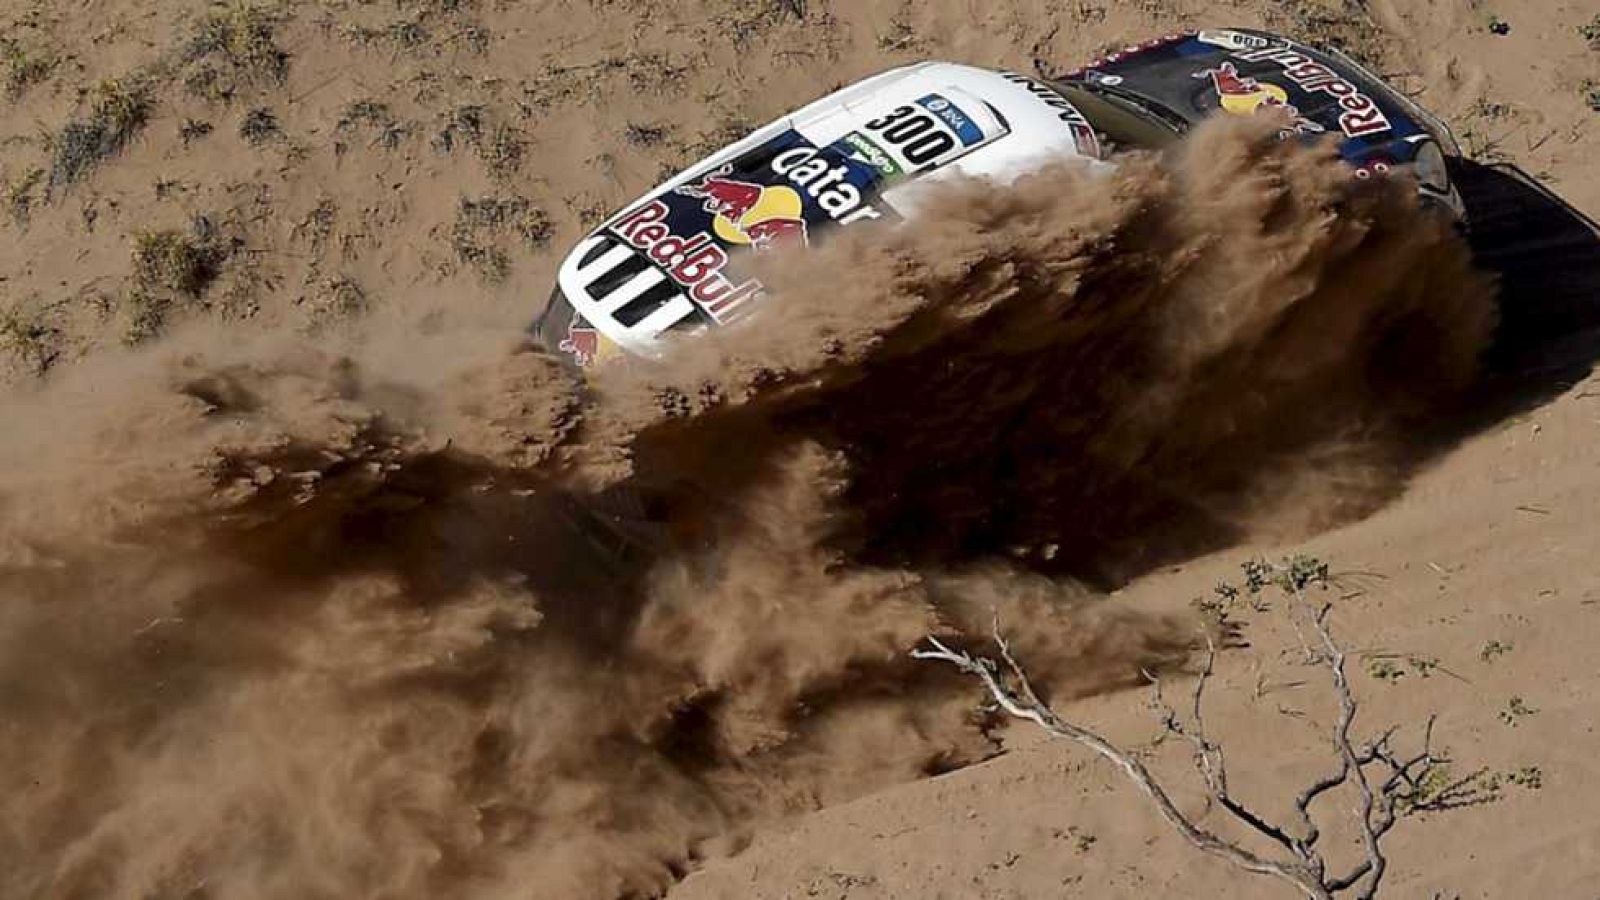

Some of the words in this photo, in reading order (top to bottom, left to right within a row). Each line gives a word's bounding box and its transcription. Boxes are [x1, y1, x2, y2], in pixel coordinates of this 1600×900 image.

[1002, 75, 1082, 121] MINI
[865, 106, 955, 165] 300
[771, 146, 881, 225] Qatar
